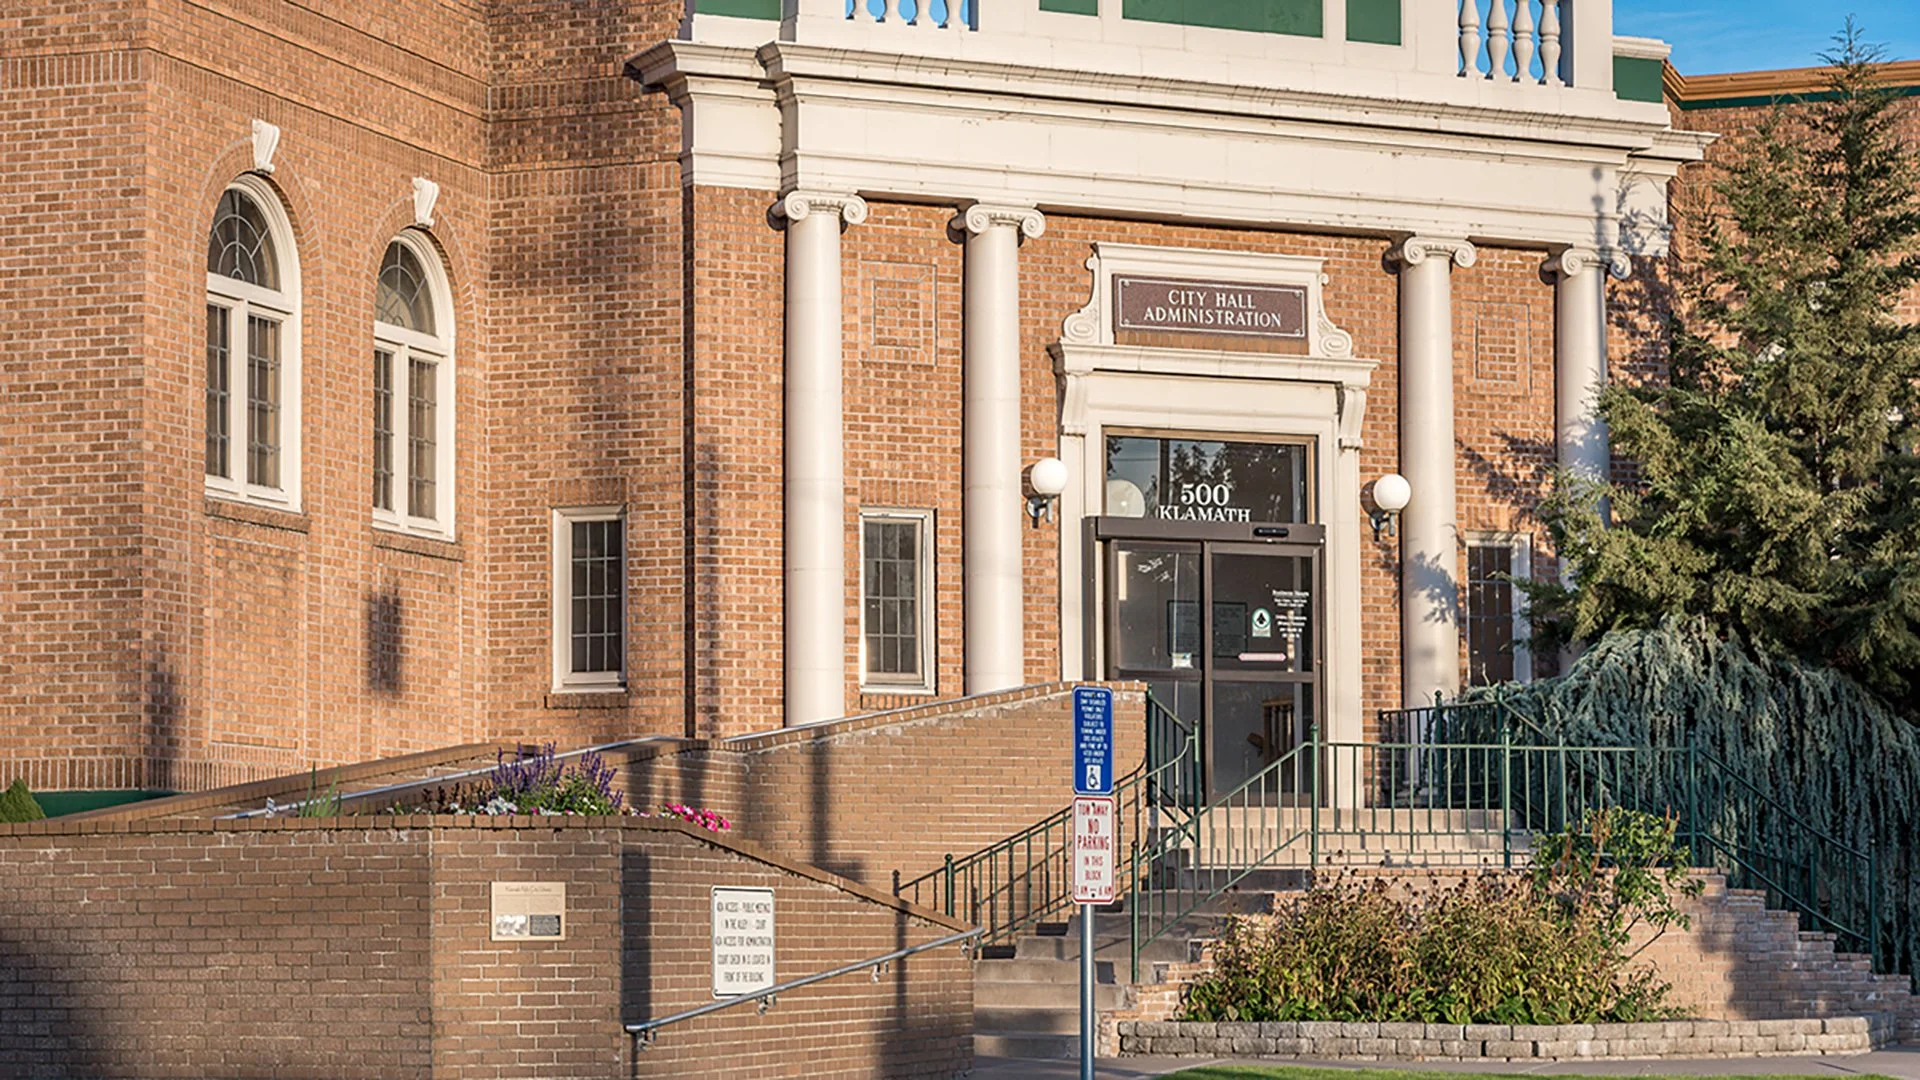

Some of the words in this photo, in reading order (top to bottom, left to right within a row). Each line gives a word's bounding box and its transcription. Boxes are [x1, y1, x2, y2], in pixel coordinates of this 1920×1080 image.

[1168, 289, 1207, 306] CITY
[1216, 292, 1257, 309] HALL
[1144, 307, 1281, 327] ADMINISTRATION
[1180, 483, 1230, 507] 500
[1159, 505, 1251, 523] KLAMATH
[1078, 804, 1090, 816] TOW
[1093, 804, 1109, 816] AWAY
[1087, 818, 1100, 835] NO
[1077, 834, 1110, 851] PARKING
[1084, 870, 1102, 881] BLOCK
